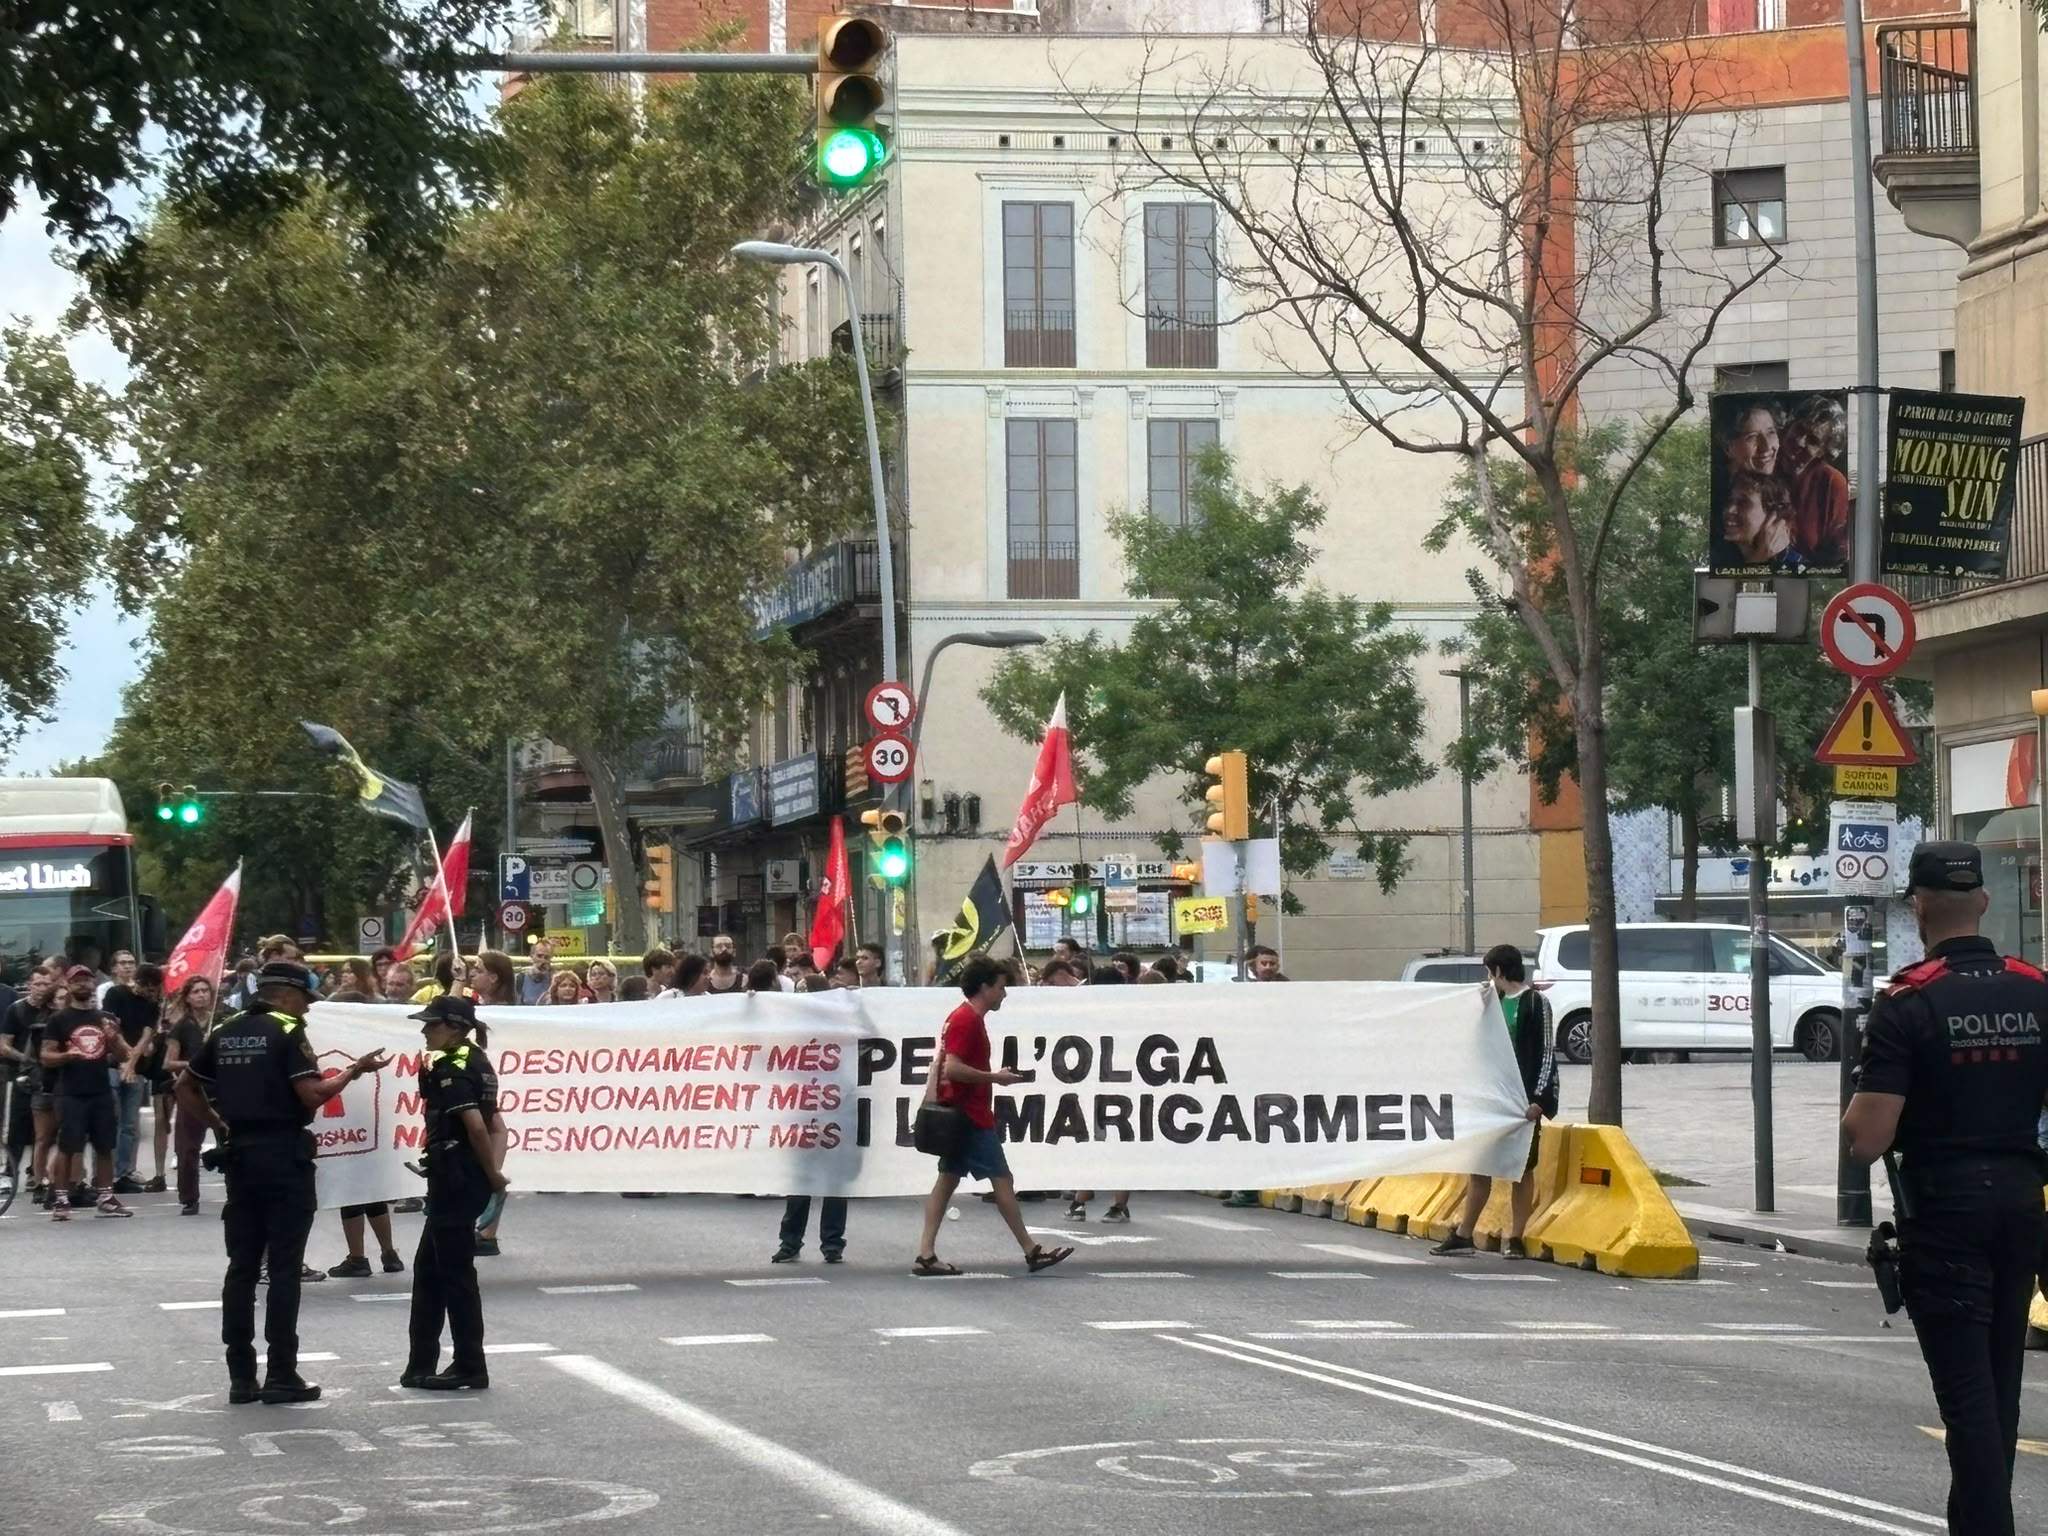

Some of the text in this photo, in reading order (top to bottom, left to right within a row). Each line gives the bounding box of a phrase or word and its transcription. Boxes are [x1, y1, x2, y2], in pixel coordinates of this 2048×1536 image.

[1893, 438, 2009, 481] MORNING
[1940, 478, 2001, 521] SUN
[876, 749, 904, 766] 30
[1842, 781, 1889, 792] CAMIONS
[1844, 770, 1889, 780] SORTIDA
[0, 866, 29, 890] st
[506, 857, 526, 882] P
[1842, 861, 1854, 872] 10
[505, 911, 524, 923] 30
[1947, 1012, 2040, 1036] POLICIA
[219, 1036, 267, 1048] POLICIA
[498, 1044, 762, 1075] DESNONAMENT
[767, 1038, 842, 1072] MÉS
[858, 1034, 1228, 1087] PE L'OLGA
[498, 1083, 761, 1114] DESNONAMENT
[768, 1078, 842, 1111] MÉS
[857, 1097, 872, 1147] I
[994, 1093, 1455, 1145] MARICARMEN
[769, 1118, 842, 1150] MÉS
